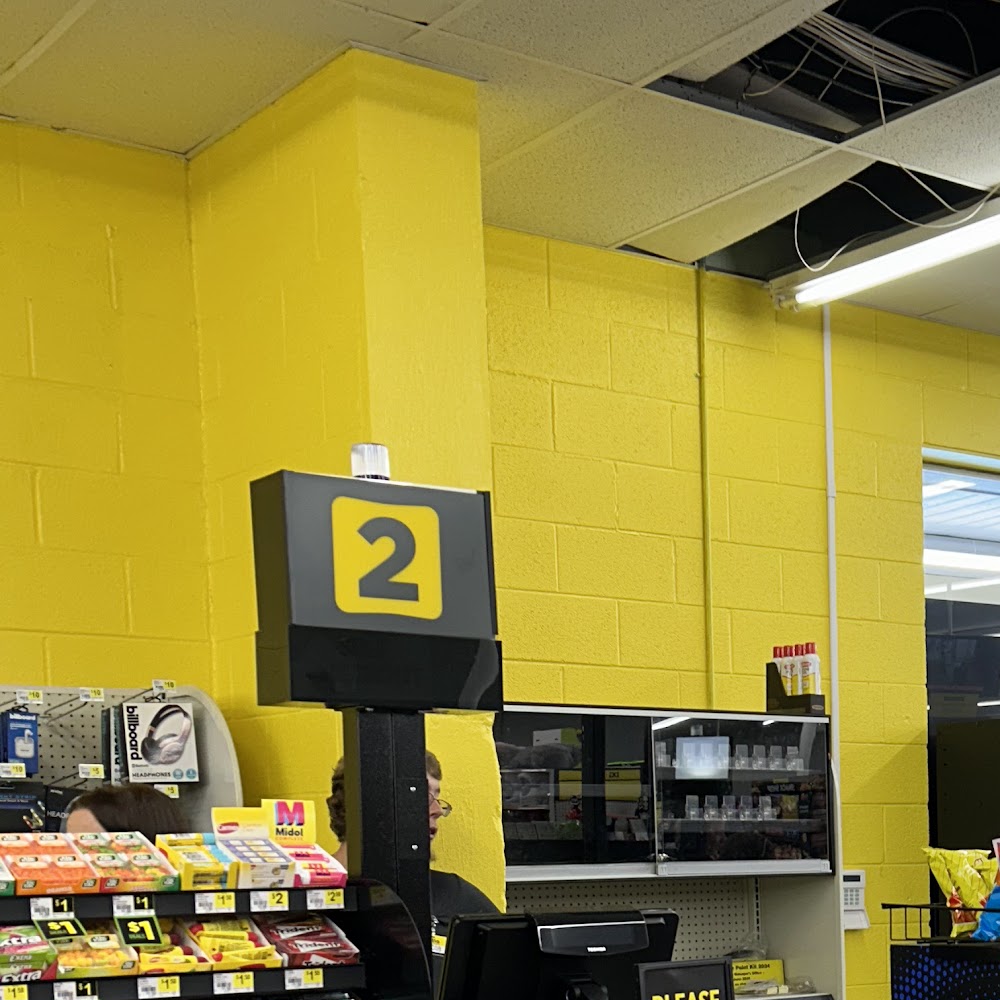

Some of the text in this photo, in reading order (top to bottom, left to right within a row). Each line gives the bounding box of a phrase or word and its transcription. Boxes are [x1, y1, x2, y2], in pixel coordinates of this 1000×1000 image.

[357, 516, 419, 602] 2
[9, 713, 36, 721] billboard
[126, 705, 142, 761] billboard
[275, 801, 305, 826] M
[275, 827, 304, 837] Midol
[136, 897, 149, 910] $1
[272, 892, 283, 904] $2
[55, 899, 68, 912] $1
[48, 920, 78, 935] $1
[128, 920, 156, 941] $1
[289, 940, 344, 950] Trident
[78, 982, 92, 996] $1
